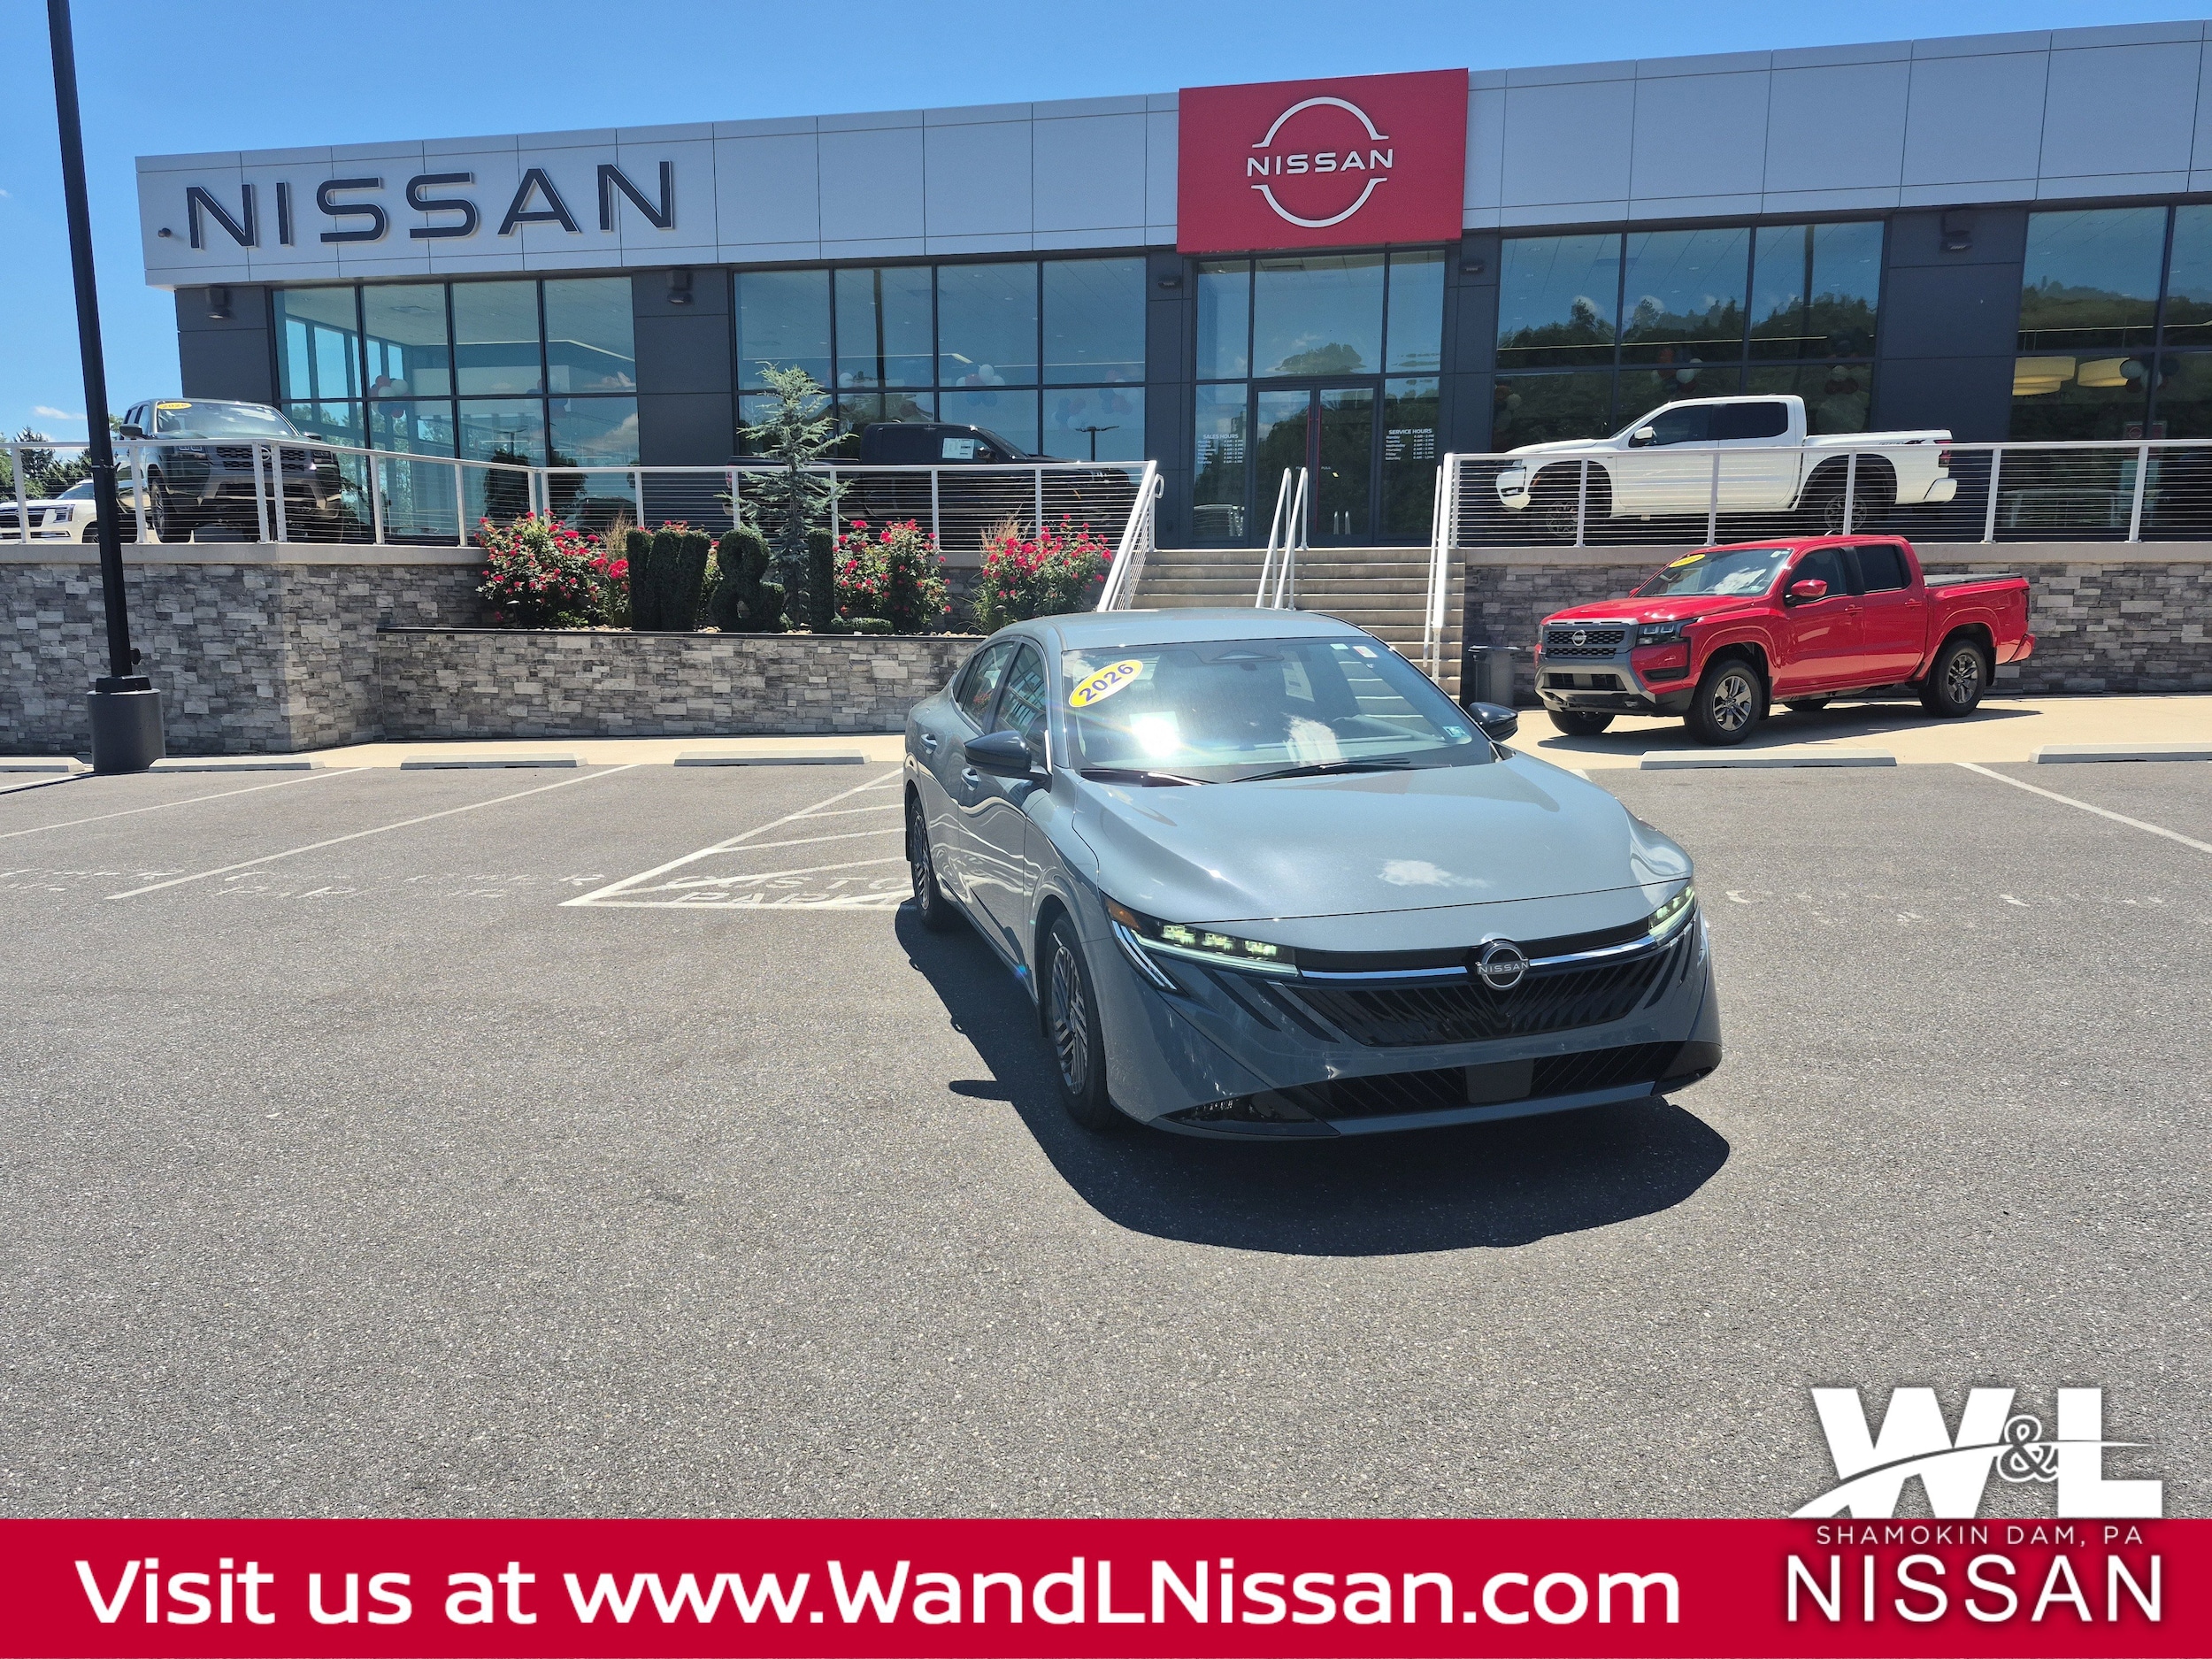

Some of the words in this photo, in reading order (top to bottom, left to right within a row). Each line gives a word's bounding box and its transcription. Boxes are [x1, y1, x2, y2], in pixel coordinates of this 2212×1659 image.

[1247, 149, 1394, 177] NISSAN
[186, 160, 674, 250] NISSAN
[1079, 664, 1133, 702] 2026
[1479, 961, 1528, 973] NISSAN
